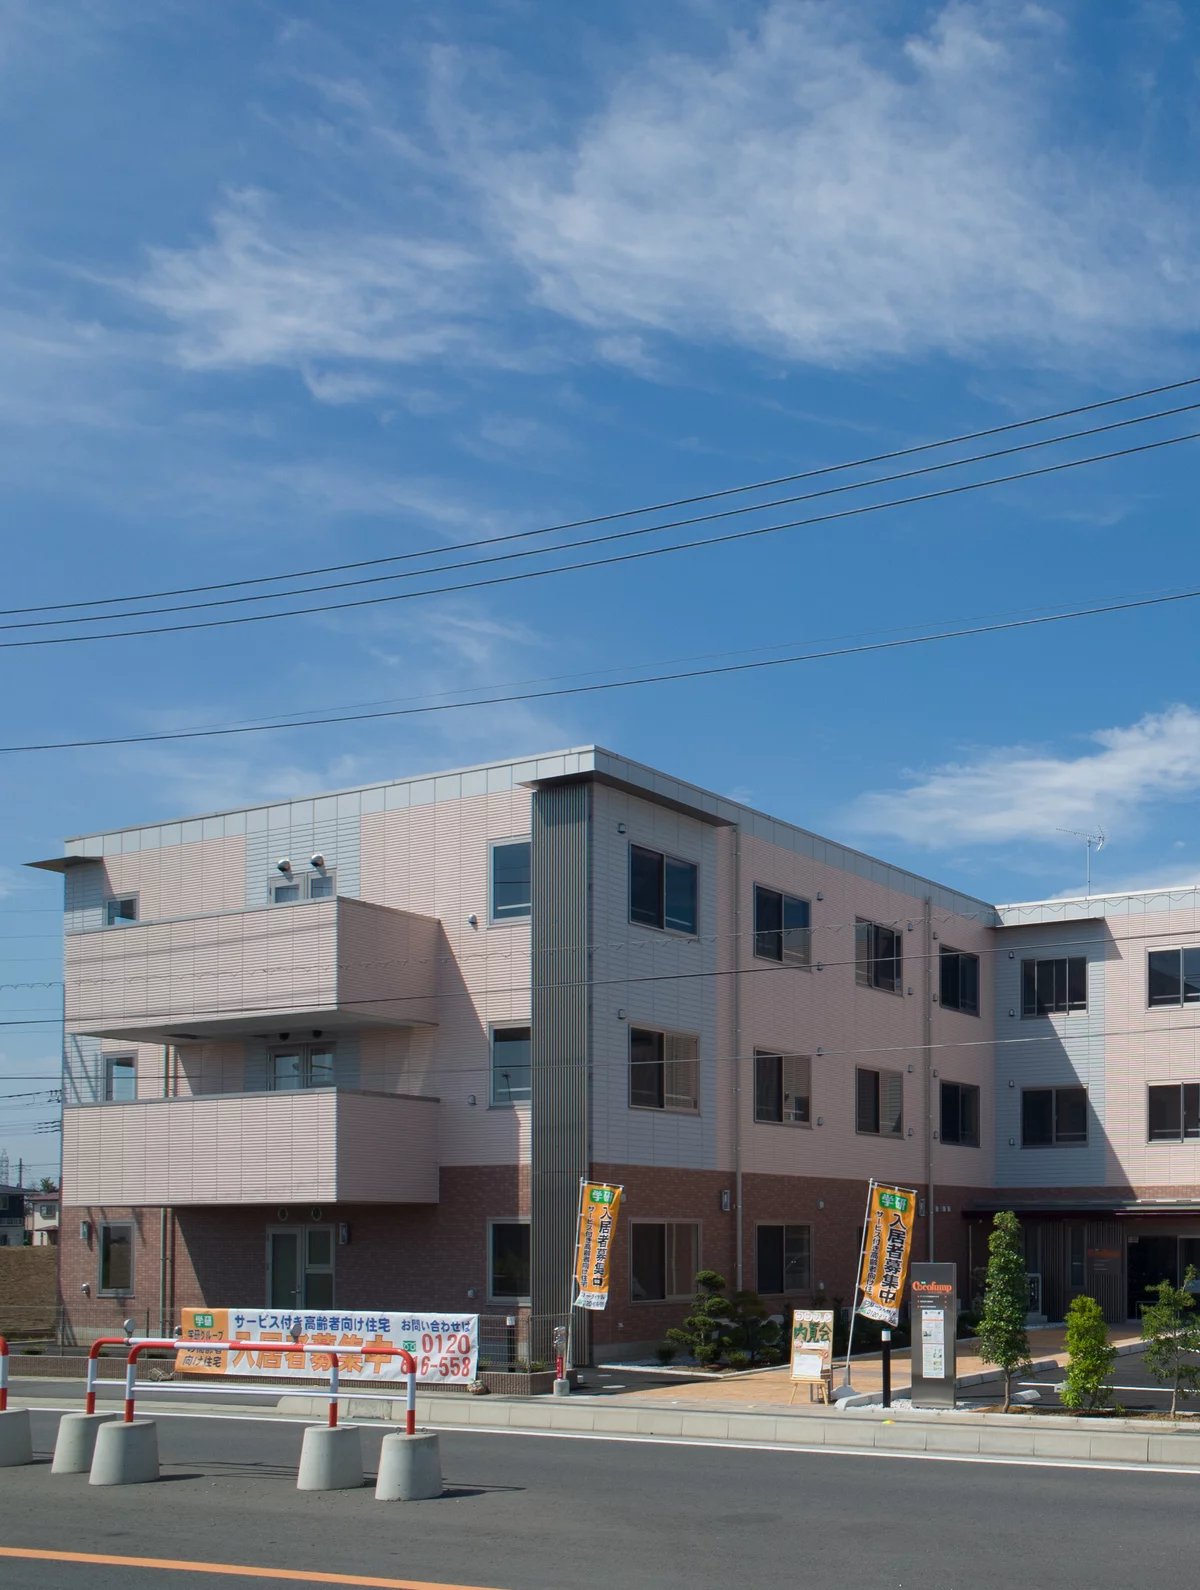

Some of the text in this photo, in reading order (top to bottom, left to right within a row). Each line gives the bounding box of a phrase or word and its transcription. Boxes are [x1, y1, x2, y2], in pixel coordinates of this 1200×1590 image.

[881, 1193, 907, 1211] 学研
[593, 1206, 612, 1286] 入居者募集中
[879, 1213, 907, 1303] 入居者募集中
[195, 1315, 212, 1326] 学研
[235, 1314, 390, 1333] サービス付き高齢者向け住宅
[401, 1319, 471, 1332] お問い合わせは
[794, 1321, 832, 1343] 内覧会
[232, 1331, 393, 1374] 入居者募集中
[422, 1333, 471, 1354] 0120
[183, 1355, 222, 1368] 向け住宅
